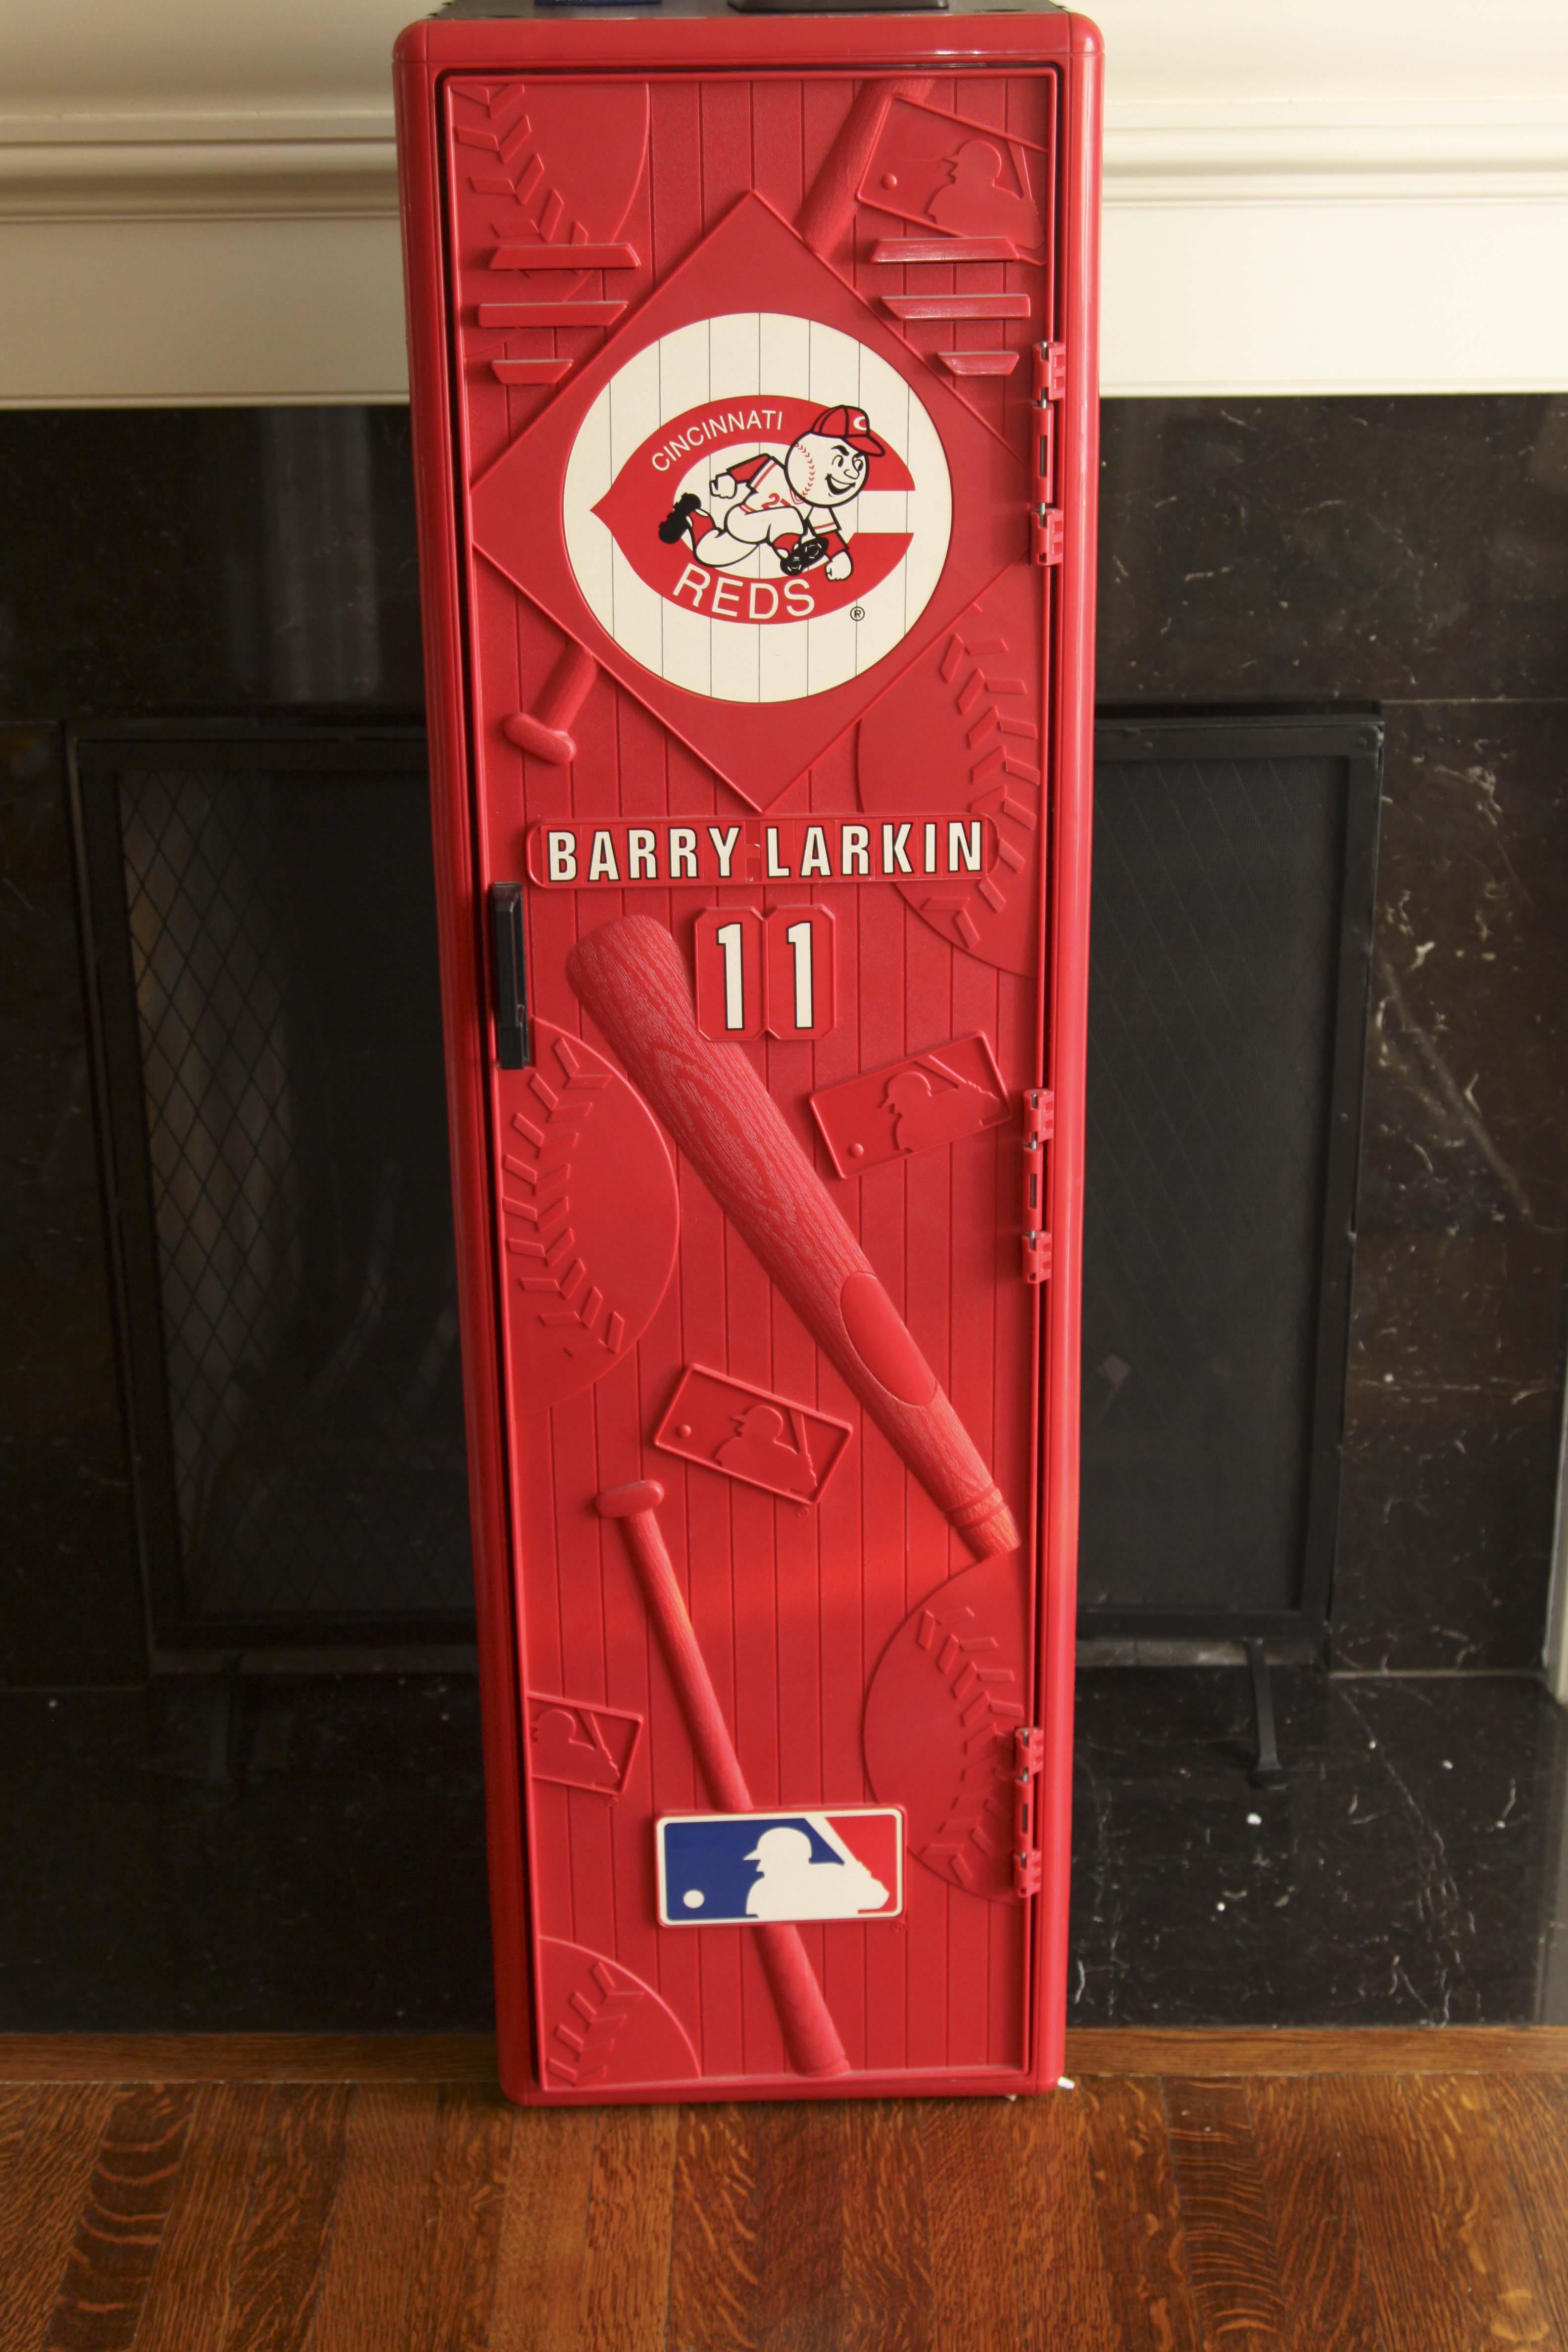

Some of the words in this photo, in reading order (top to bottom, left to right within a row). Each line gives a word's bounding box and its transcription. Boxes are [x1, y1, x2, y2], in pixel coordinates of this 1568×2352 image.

[652, 410, 783, 471] CINCINNATI
[673, 563, 815, 620] REDS
[547, 826, 741, 882] BARRY
[766, 820, 981, 878] LARKIN
[716, 921, 814, 1030] 11
